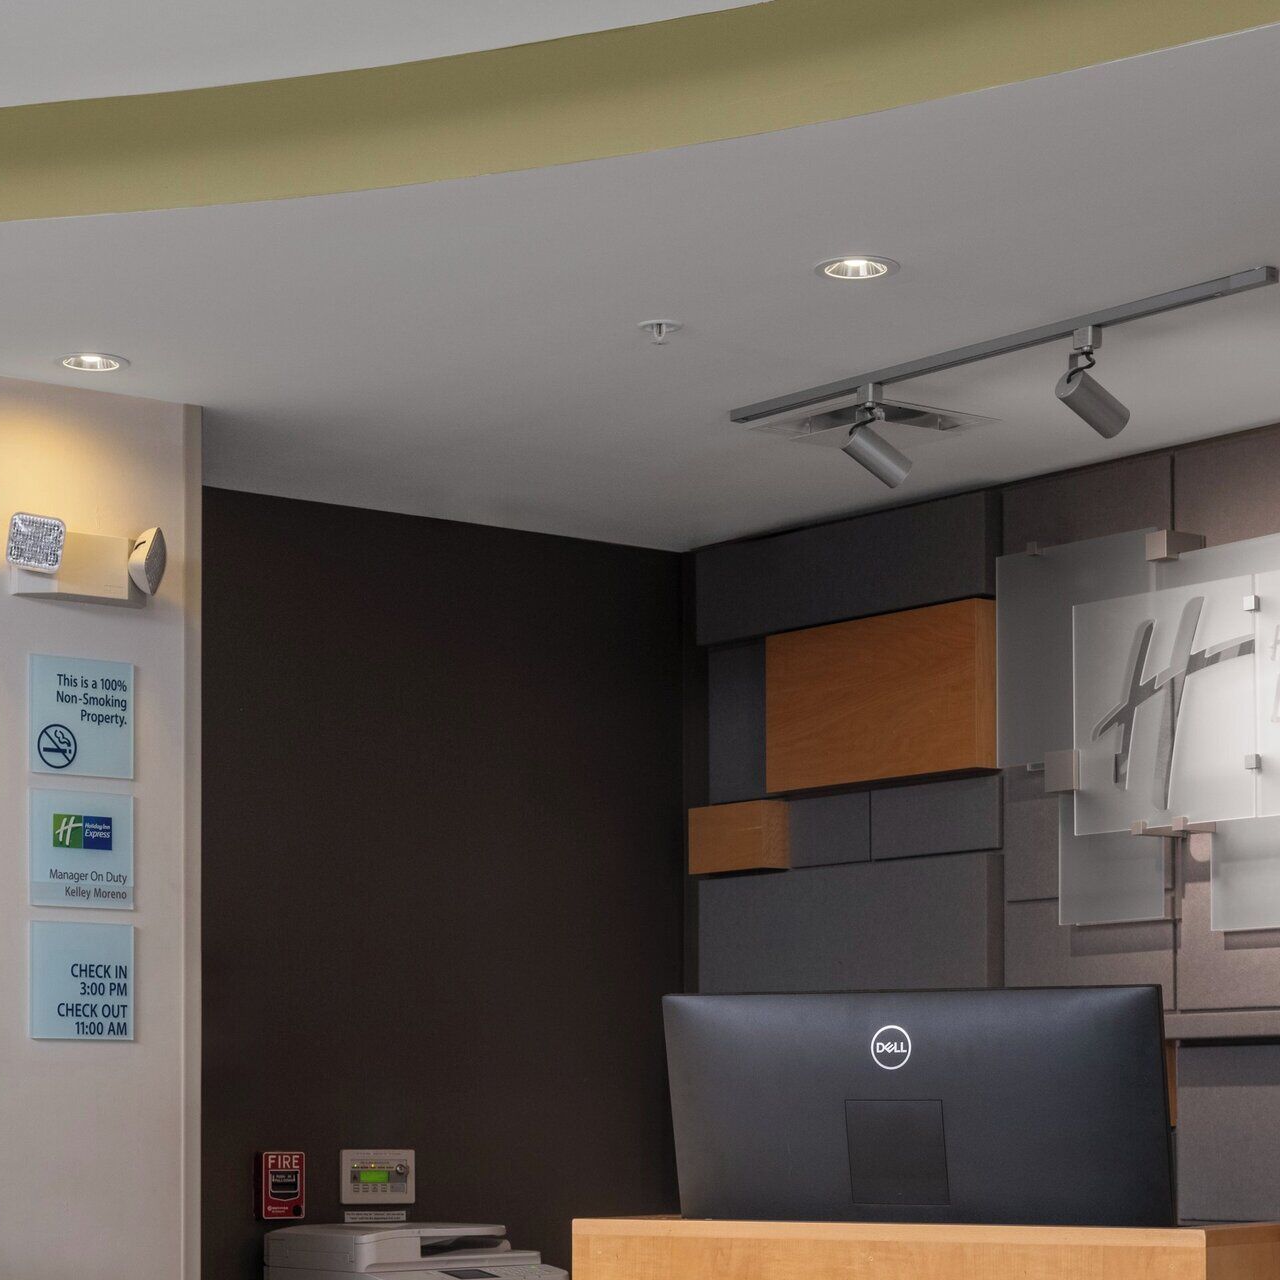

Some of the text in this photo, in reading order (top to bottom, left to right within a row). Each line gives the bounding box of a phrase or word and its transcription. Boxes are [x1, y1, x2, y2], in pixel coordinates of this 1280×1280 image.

[57, 674, 128, 692] This is a 100%
[56, 690, 127, 712] Non-Smoking
[80, 709, 128, 728] Property.
[84, 822, 103, 831] Holiday
[84, 829, 111, 839] Express
[49, 868, 128, 885] Manager On Duty
[65, 886, 128, 900] Kelley Moreno
[70, 963, 128, 979] CHECK IN
[80, 981, 128, 996] 3:00 PM
[57, 1002, 128, 1019] CHECK OUT
[75, 1021, 128, 1036] 11:00 AM
[876, 1042, 907, 1053] DELL
[268, 1155, 300, 1169] FIRE
